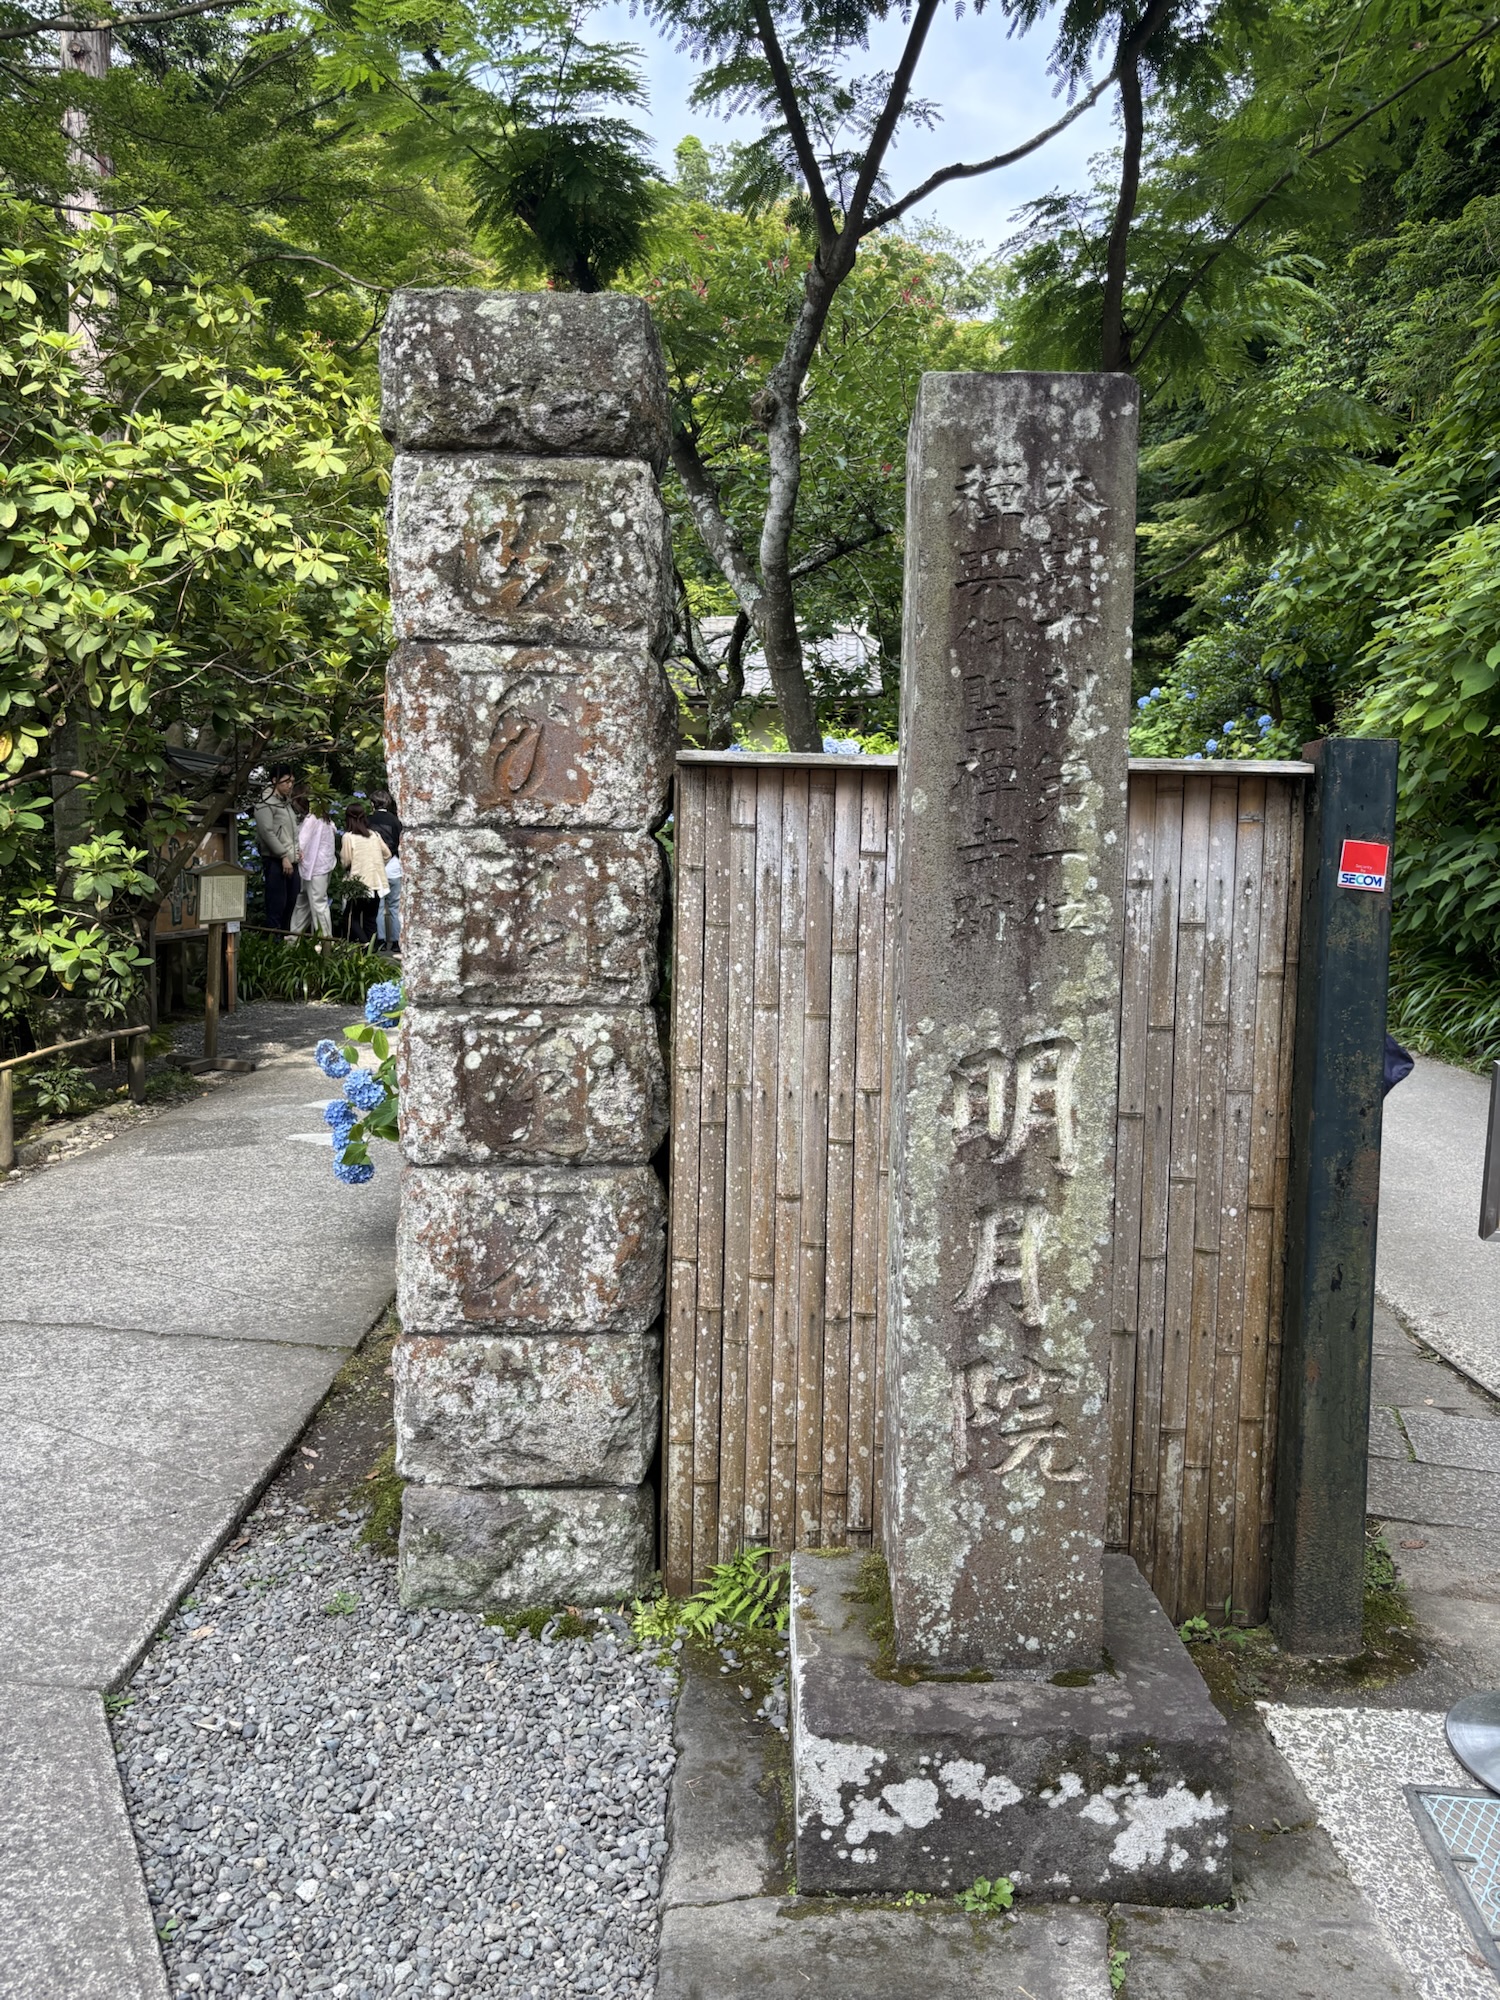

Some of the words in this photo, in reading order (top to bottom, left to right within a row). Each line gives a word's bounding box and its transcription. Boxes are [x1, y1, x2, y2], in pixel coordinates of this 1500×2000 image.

[1341, 874, 1382, 887] SECOM
[948, 1034, 1088, 1482] 明月院
